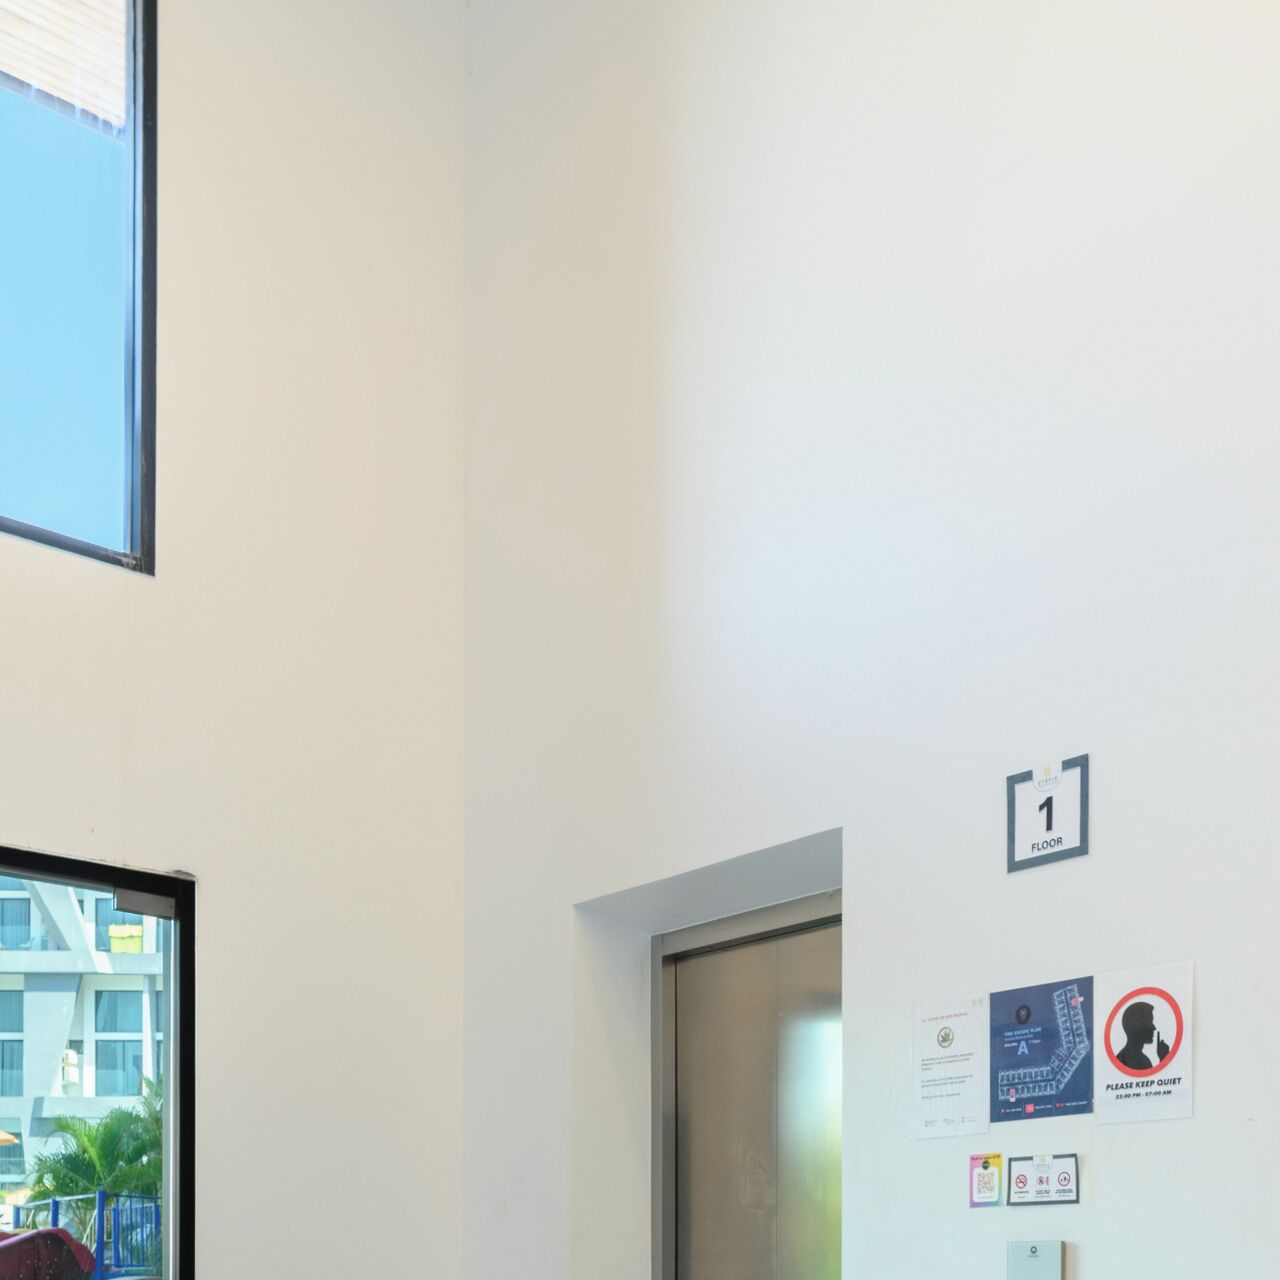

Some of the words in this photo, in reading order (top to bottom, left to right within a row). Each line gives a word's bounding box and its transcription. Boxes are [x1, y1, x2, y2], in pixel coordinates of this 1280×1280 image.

[1039, 796, 1053, 832] 1
[1031, 837, 1063, 853] FLOOR
[1017, 1040, 1029, 1056] A
[1106, 1081, 1133, 1091] PLEASE
[1135, 1079, 1155, 1089] KEEP
[1157, 1077, 1182, 1086] QUIET
